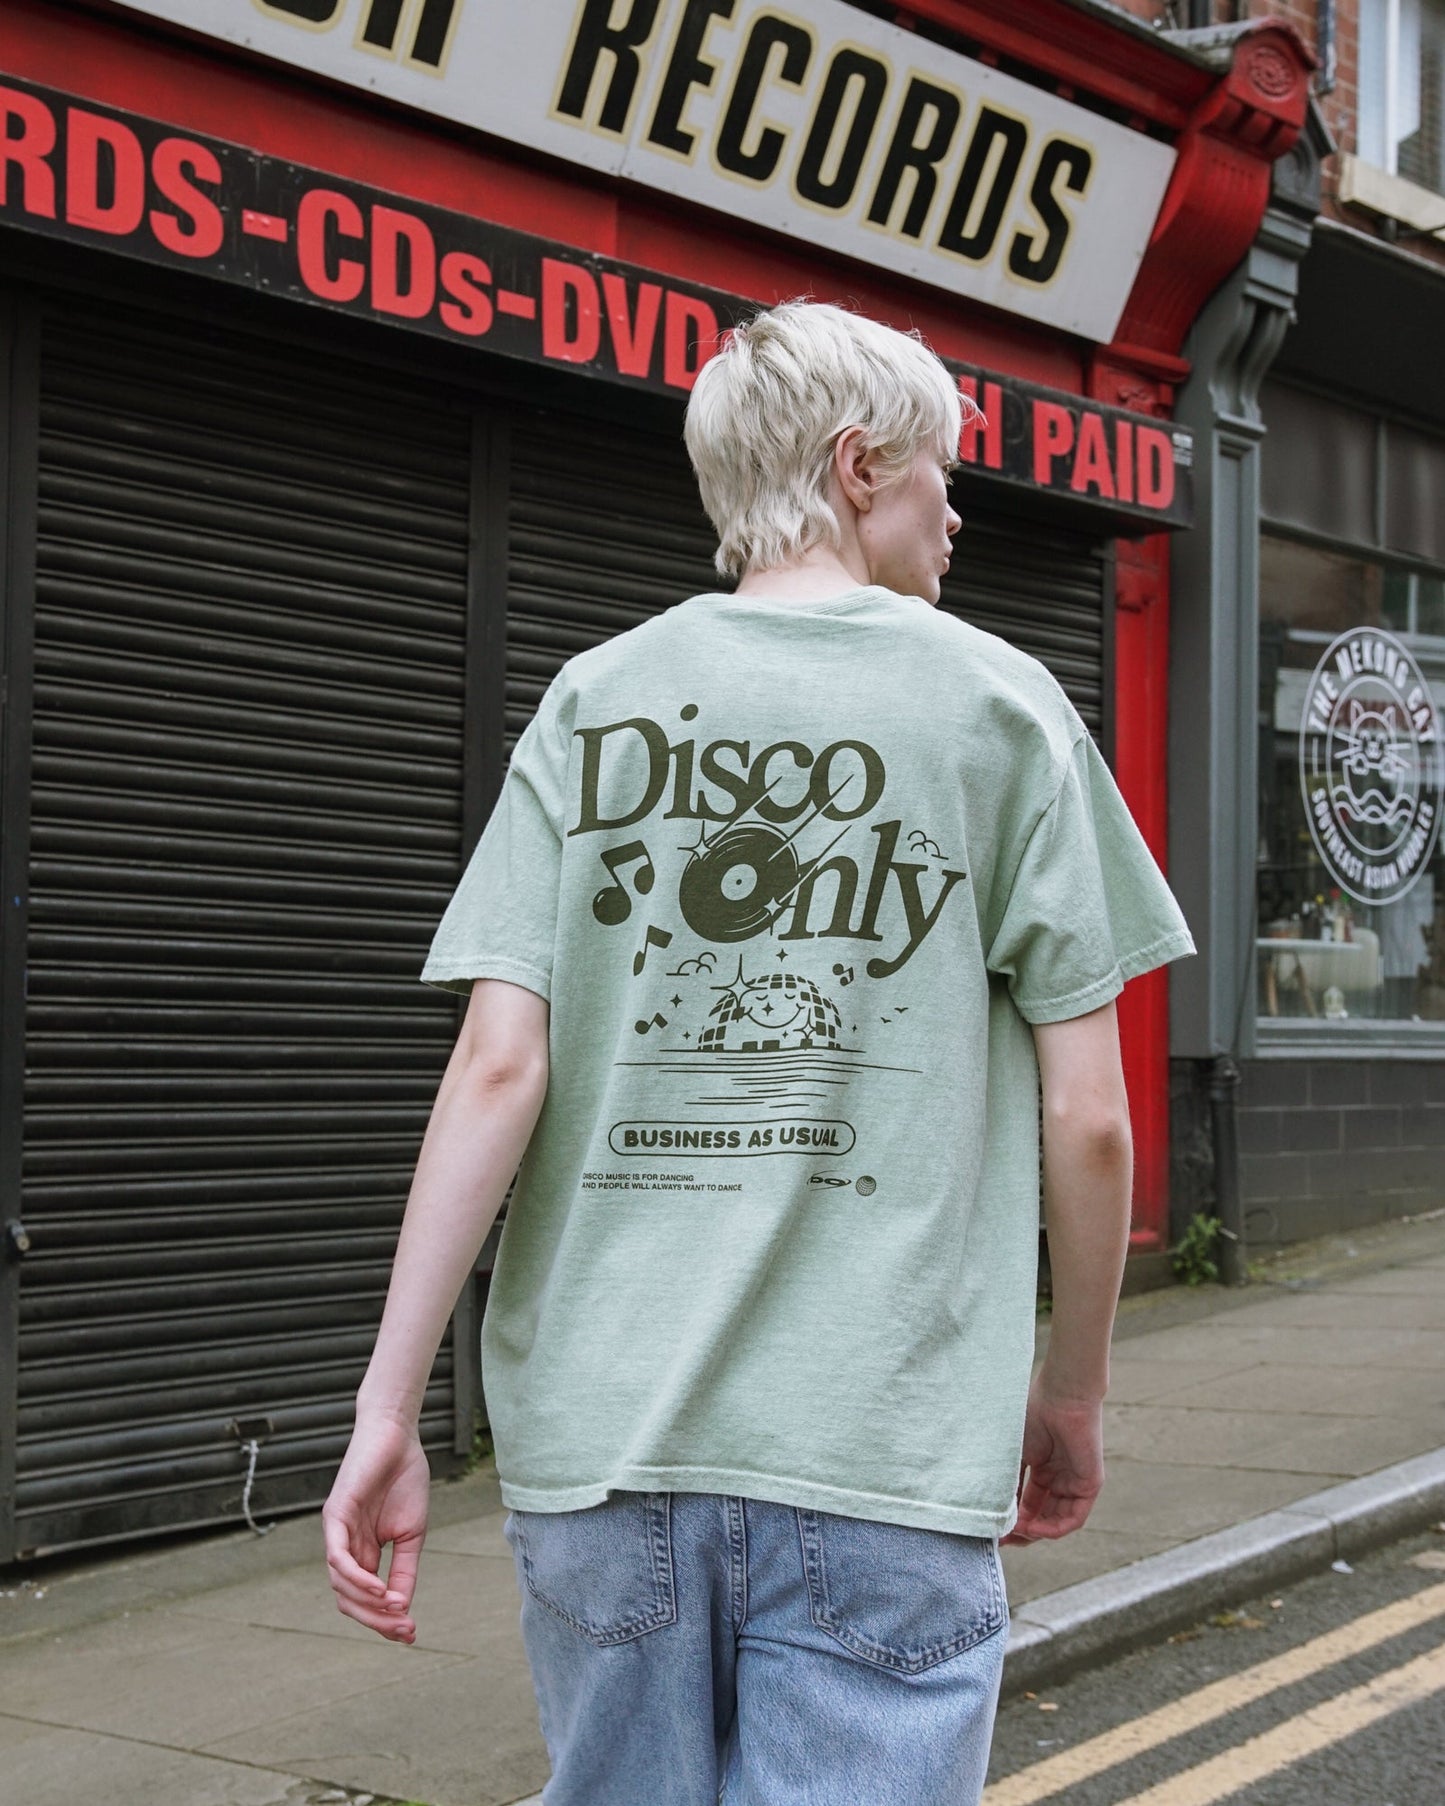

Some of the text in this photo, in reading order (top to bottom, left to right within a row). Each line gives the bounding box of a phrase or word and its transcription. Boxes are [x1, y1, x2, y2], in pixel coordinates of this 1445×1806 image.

[556, 0, 1094, 286] RECORDS
[1033, 400, 1174, 510] PAID
[1308, 670, 1339, 732] THE
[1407, 686, 1435, 743] CAT
[568, 704, 886, 836] Disco
[624, 1126, 840, 1149] BUSINESS AS USUAL
[582, 1182, 743, 1192] AND PEOPLE WILL ALWAYS WANT TO DANCE
[583, 1172, 695, 1183] DISCO MUSIC IS FOR DANCING
